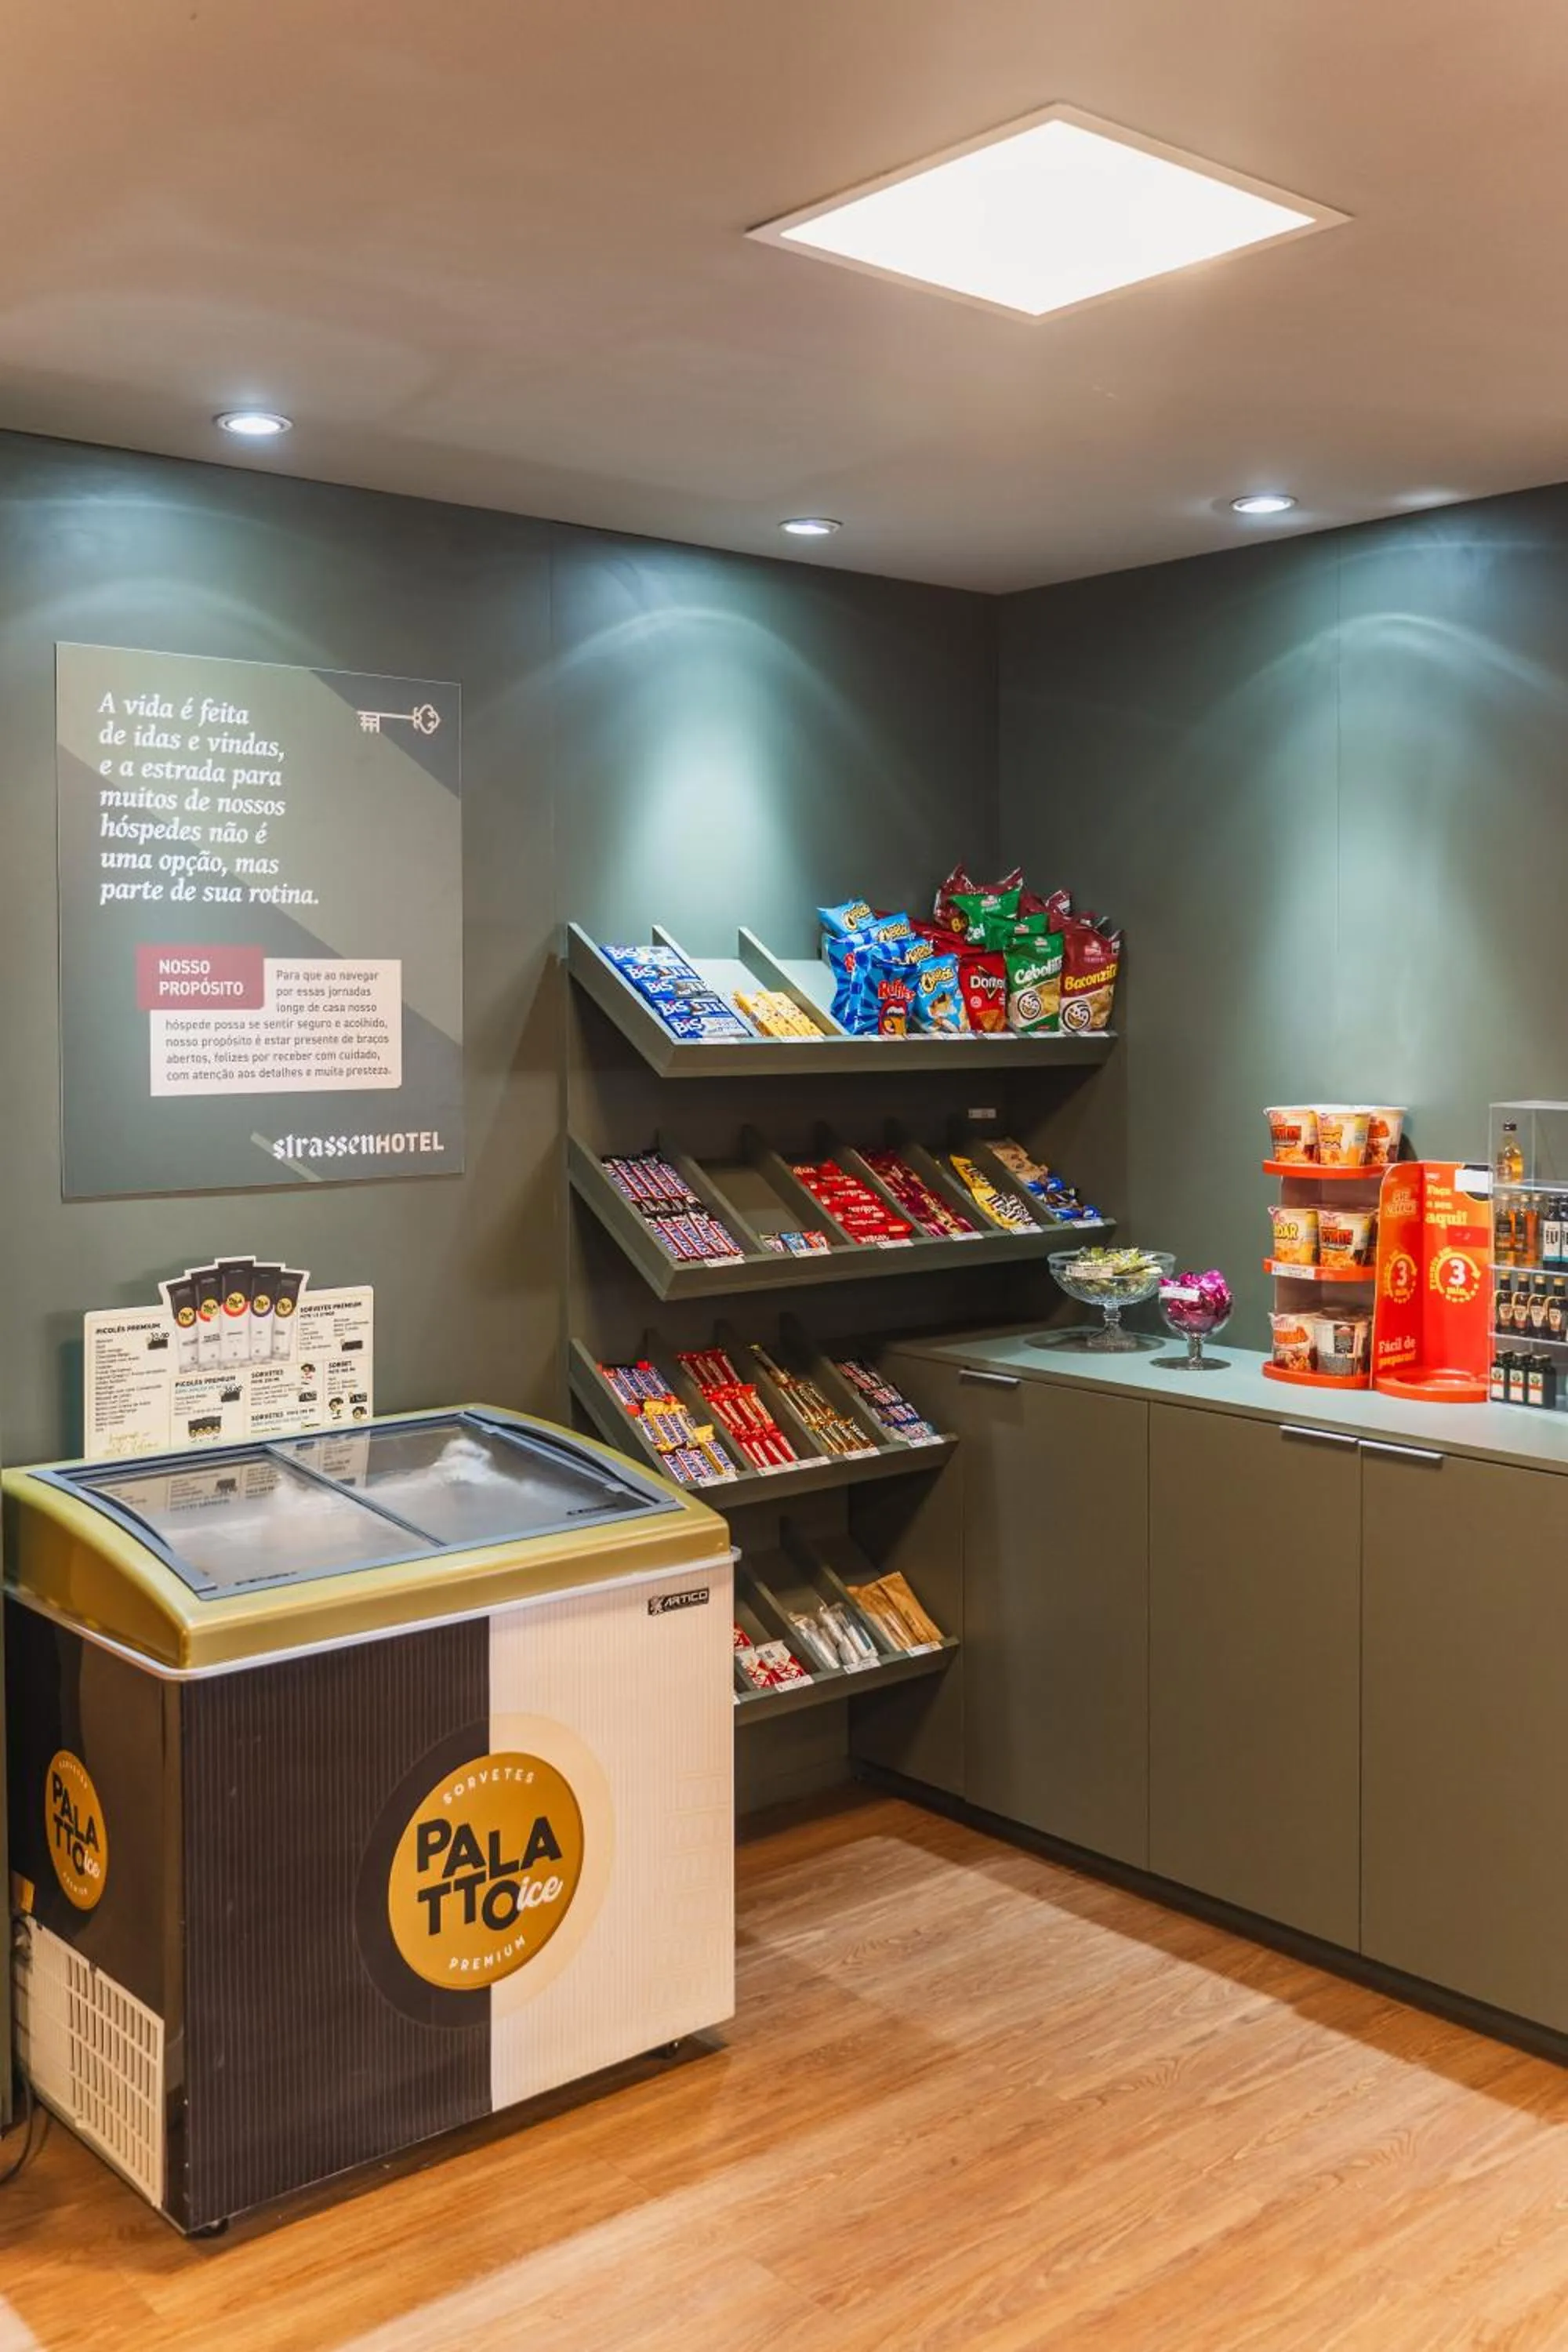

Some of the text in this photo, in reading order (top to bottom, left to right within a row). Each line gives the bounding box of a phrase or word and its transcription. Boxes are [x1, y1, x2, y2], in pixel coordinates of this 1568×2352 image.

[98, 692, 249, 727] A vida é feita
[99, 720, 284, 762] de idas e vindas,
[100, 757, 281, 789] e a estrada para
[100, 788, 285, 815] muitos de nossos
[100, 813, 267, 845] hóspedes não é
[100, 851, 279, 877] uma opção, mas
[100, 877, 318, 906] parte de sua rotina.
[159, 959, 210, 974] NOSSO
[276, 970, 299, 980] Para
[303, 972, 321, 982] que
[159, 978, 244, 996] PROPÓSITO
[276, 989, 293, 998] por
[201, 1035, 252, 1049] propósito
[294, 1036, 339, 1047] presente
[252, 1054, 270, 1064] por
[273, 1051, 312, 1062] receber
[339, 1049, 380, 1061] cuidado,
[274, 1131, 444, 1160] strassenHOTEL
[1425, 1210, 1468, 1229] aqui!
[1396, 1260, 1407, 1287] 3
[1449, 1258, 1466, 1285] 3
[443, 1768, 535, 1805] SORVETES
[417, 1816, 563, 1881] PALA
[417, 1871, 564, 1931] TTO ice
[449, 1934, 527, 1971] PREMIUM
